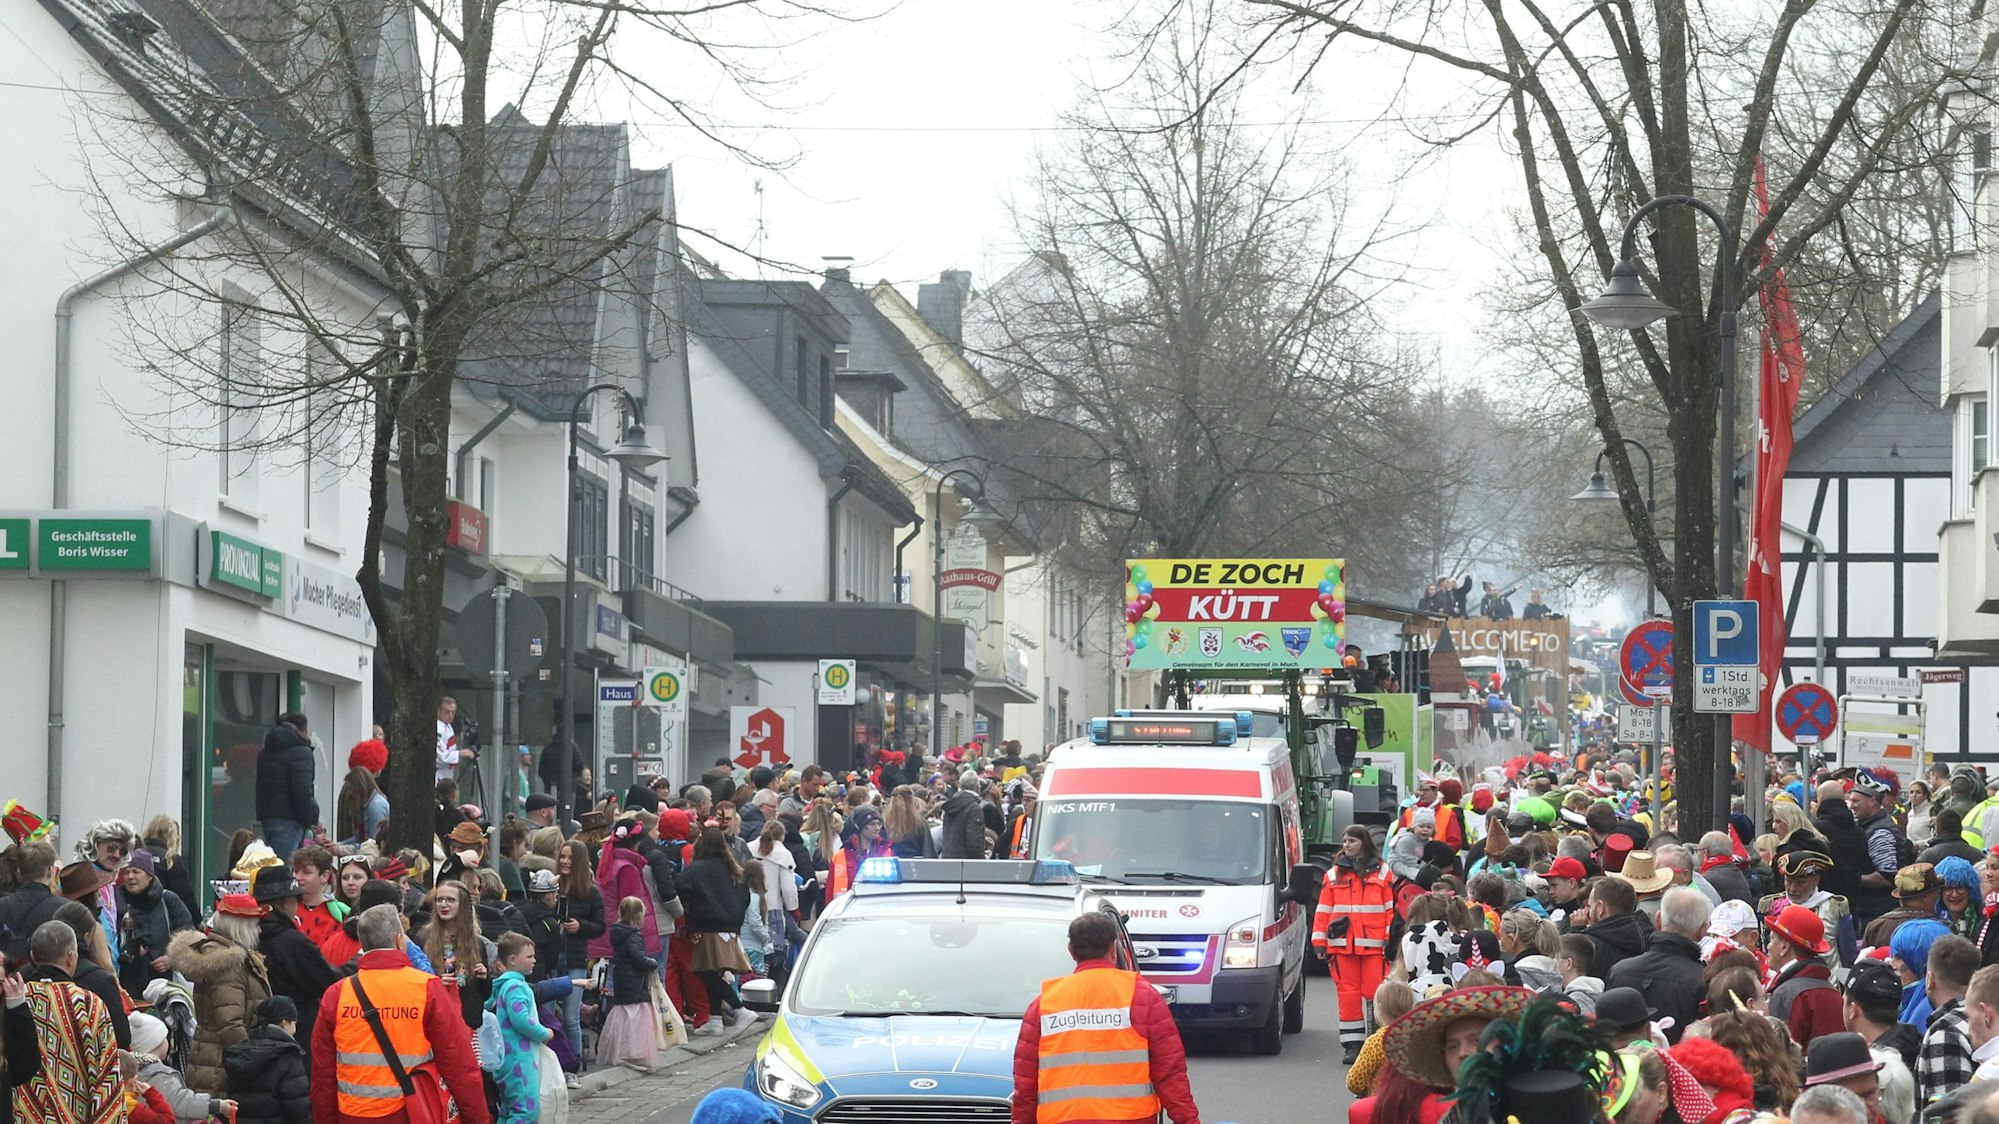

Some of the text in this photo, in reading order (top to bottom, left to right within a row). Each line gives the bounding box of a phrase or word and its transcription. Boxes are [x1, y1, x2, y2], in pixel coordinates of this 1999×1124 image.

[51, 531, 137, 542] Geschäftsstelle
[58, 547, 128, 557] Boris Wisser
[220, 541, 260, 582] PROVINZIAL
[940, 572, 997, 586] Rathaus-Grill
[1170, 564, 1305, 584] DE ZOCH
[303, 576, 326, 606] Mucher
[326, 584, 362, 618] Pflegedienst
[1187, 589, 1280, 620] KÜTT
[1709, 609, 1743, 657] P
[1534, 632, 1560, 652] TO
[1849, 676, 1920, 688] Rechtsanwalt
[1924, 673, 1962, 682] Jägerweg
[606, 688, 632, 699] Haus
[1702, 686, 1751, 696] werktags
[1711, 697, 1734, 707] 8-18
[1457, 713, 1463, 721] 3
[1630, 709, 1654, 717] Mo-F
[1631, 719, 1652, 727] 8-18
[1623, 729, 1636, 739] Sa
[1639, 730, 1654, 739] 8-1
[1047, 802, 1116, 815] NKS MTF 1
[1120, 909, 1168, 919] NNITER
[341, 1006, 419, 1020] ZUGEITUNG
[1049, 1011, 1122, 1029] Zugleitung
[852, 1034, 1010, 1051] POLIZEI
